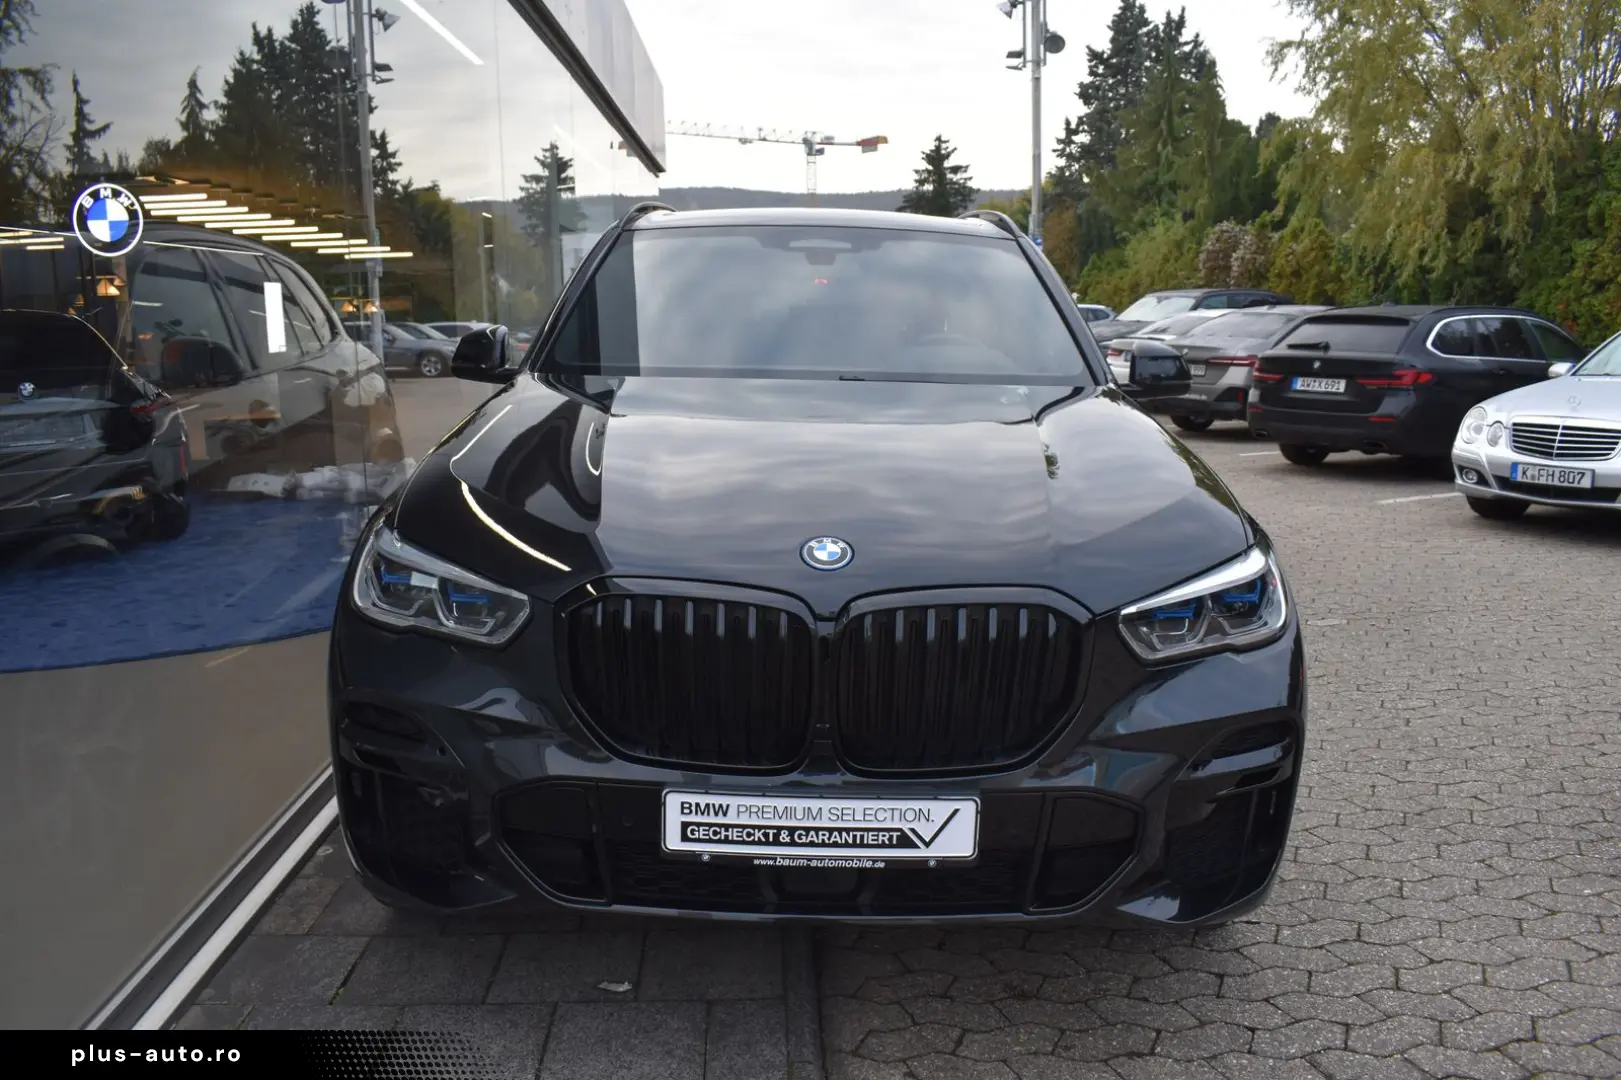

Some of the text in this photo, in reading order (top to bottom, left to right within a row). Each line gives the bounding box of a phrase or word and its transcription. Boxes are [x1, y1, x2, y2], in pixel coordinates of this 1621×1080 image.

[81, 187, 134, 209] BMW
[1521, 466, 1530, 480] K
[1558, 470, 1586, 485] 807
[680, 801, 730, 817] BMW
[736, 803, 823, 821] PREMIUM
[686, 825, 901, 845] GECHECKT & GARANTIERT
[753, 856, 886, 868] www.baum-automobile.de
